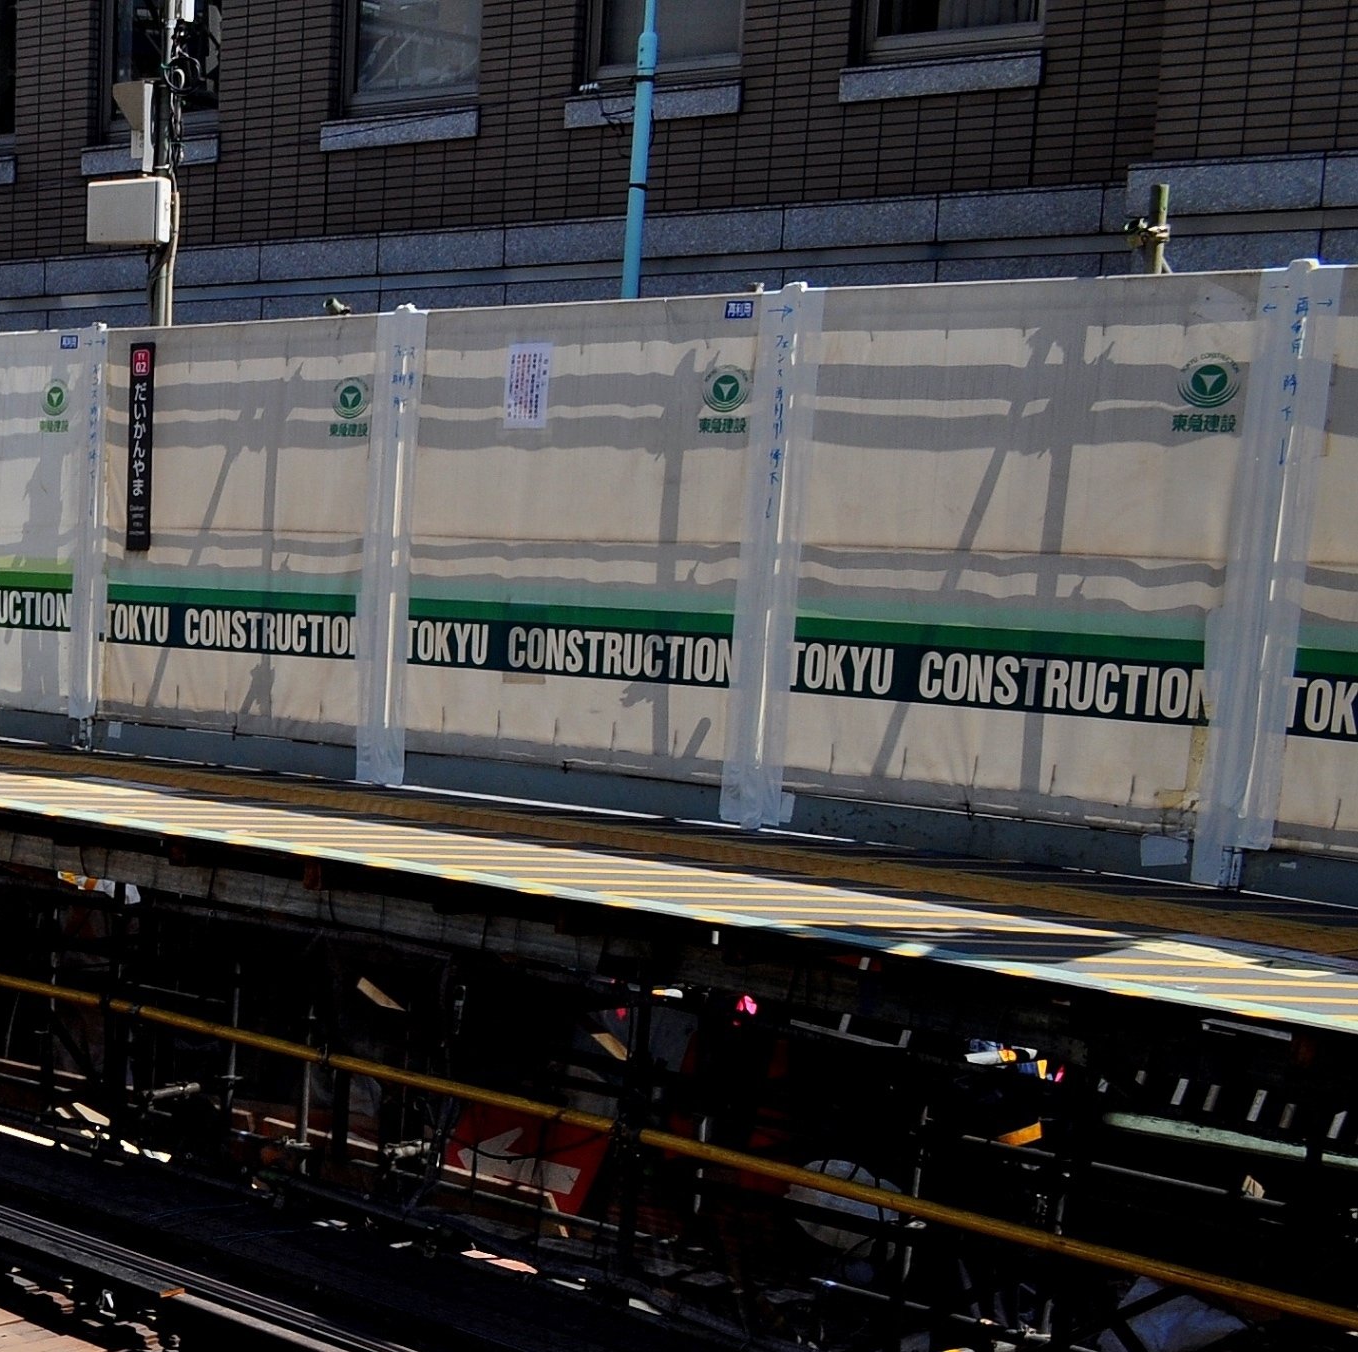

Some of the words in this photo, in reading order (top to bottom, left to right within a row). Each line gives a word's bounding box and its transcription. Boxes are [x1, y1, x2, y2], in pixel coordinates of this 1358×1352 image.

[135, 361, 148, 374] 02
[132, 381, 147, 497] だいかんやま
[698, 417, 747, 434] 東急建設
[1171, 412, 1237, 433] 東急建設
[105, 602, 170, 644] TOKYU
[406, 619, 490, 665] TOKYU
[507, 626, 733, 685] CONSTRUCTION
[789, 641, 895, 695] TOKYU
[918, 651, 1213, 721] CONSTRUCTION
